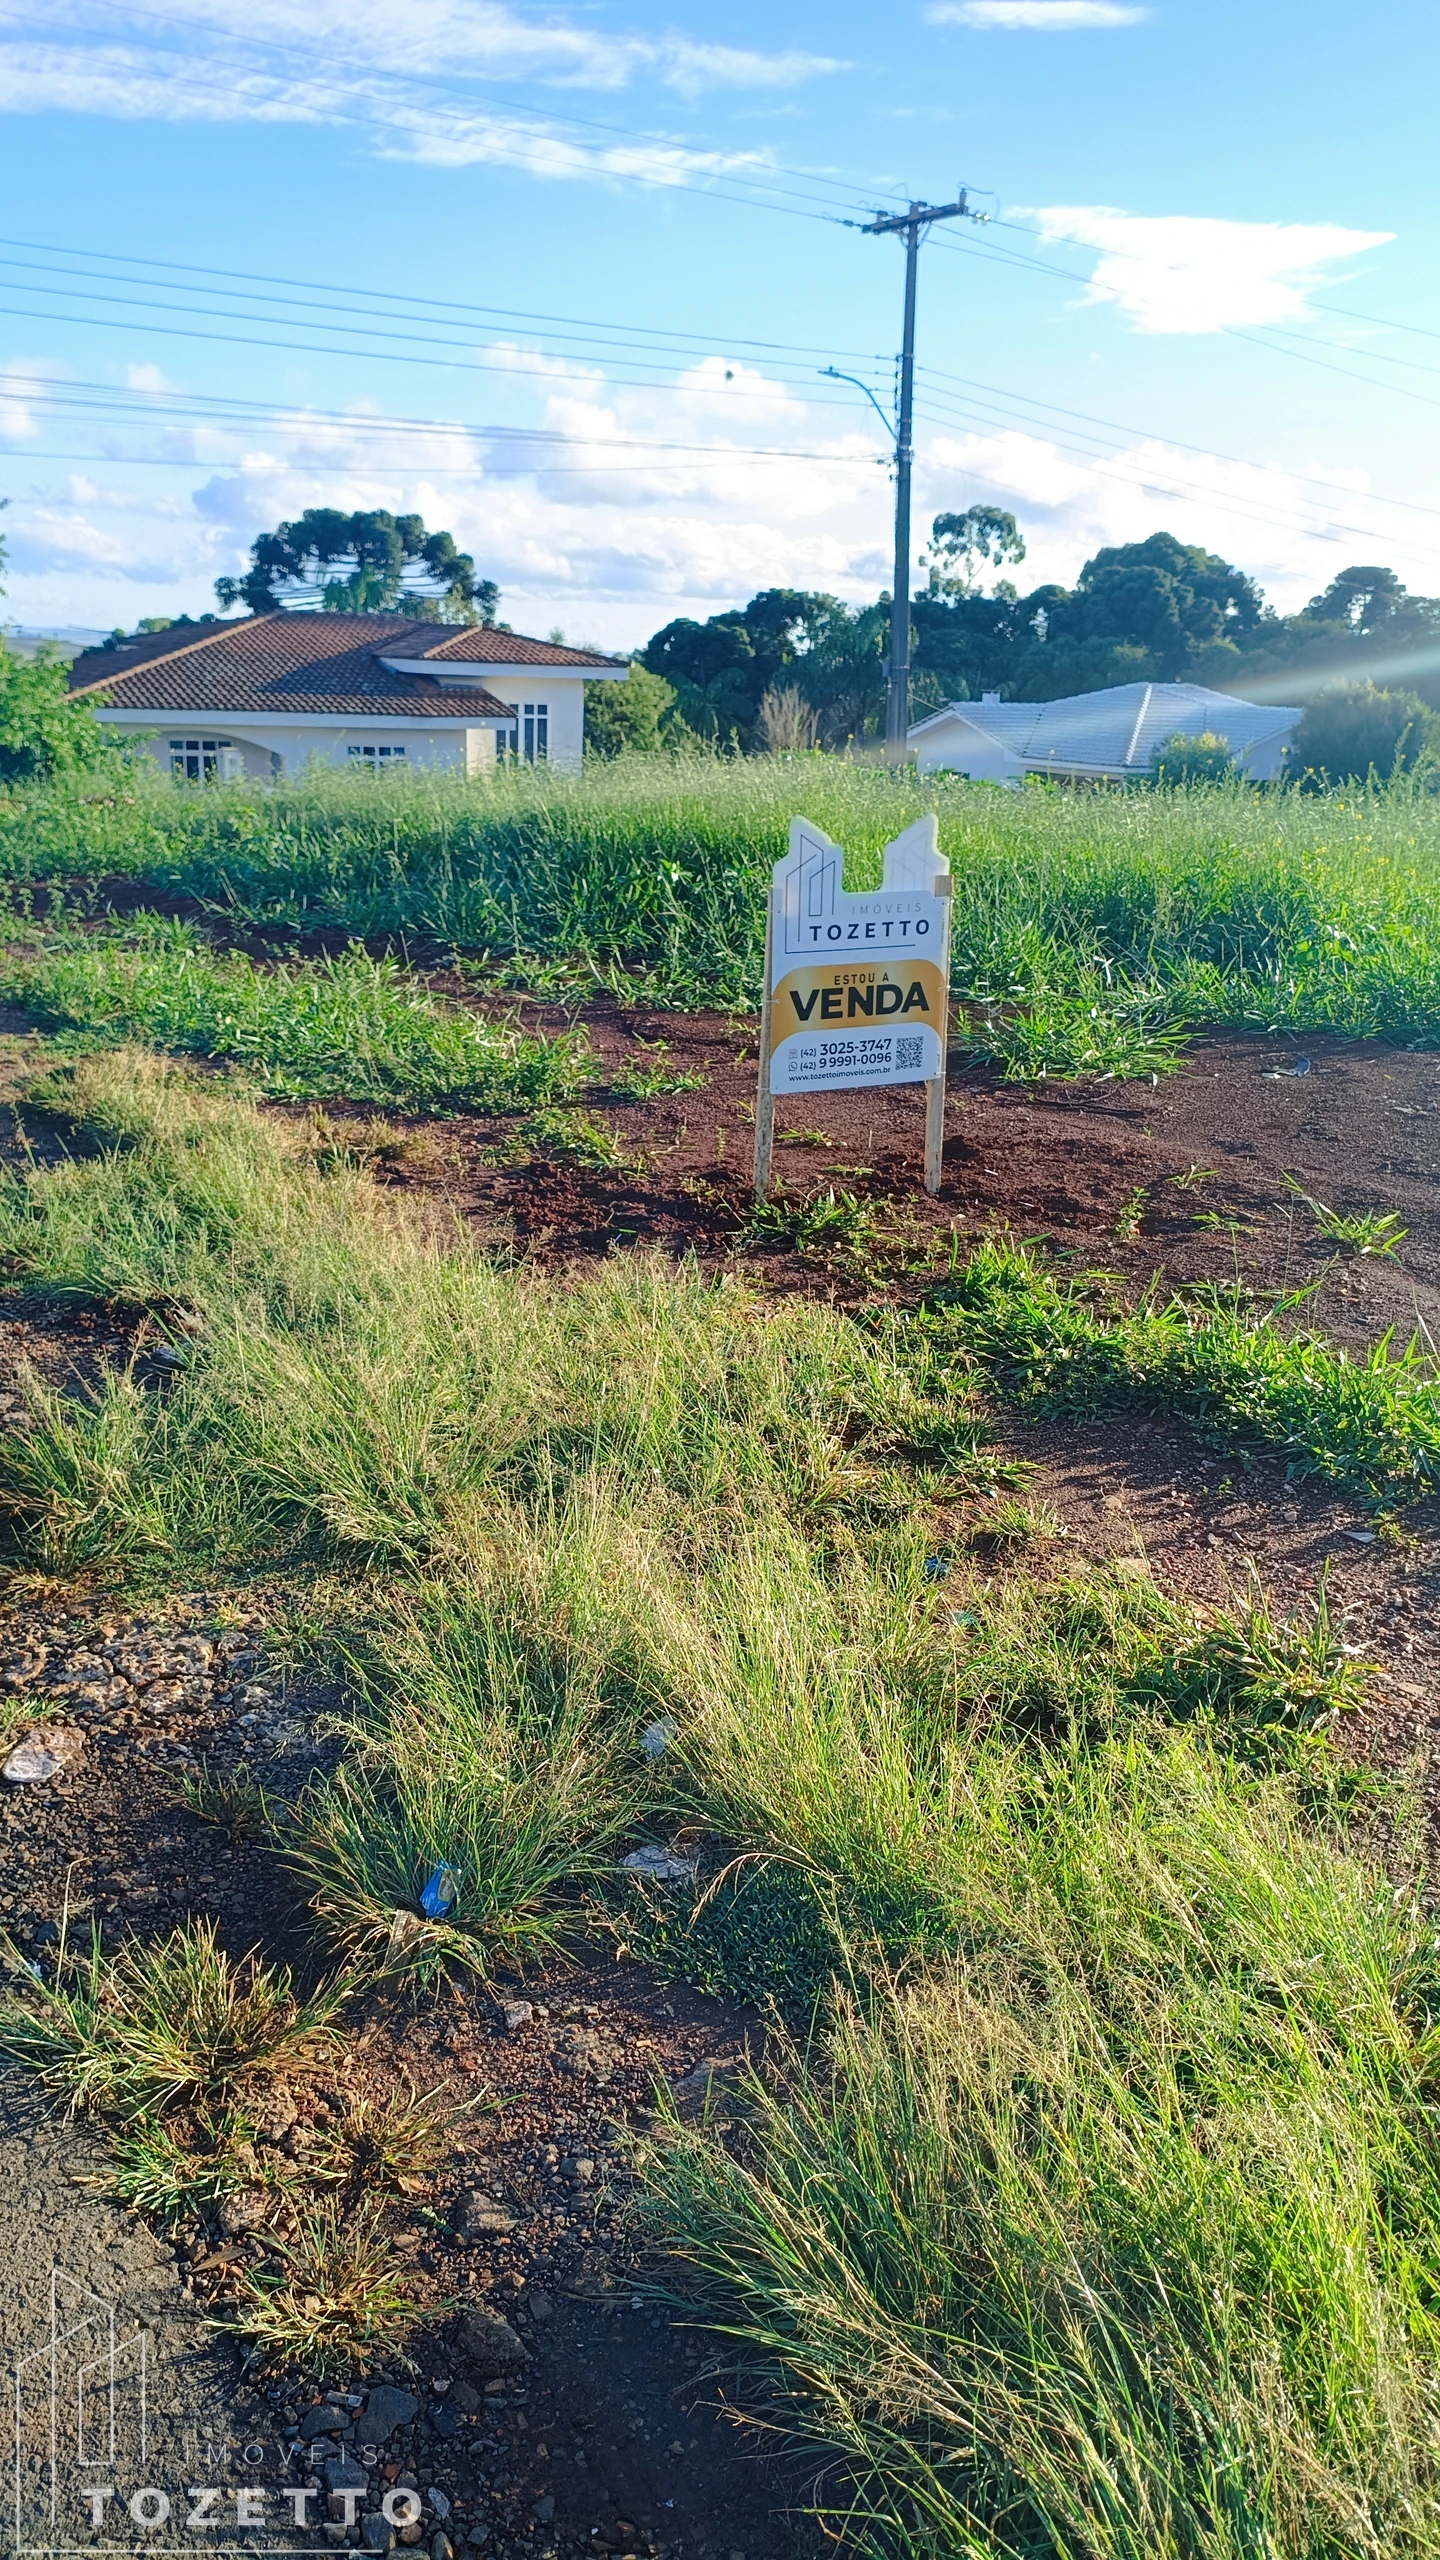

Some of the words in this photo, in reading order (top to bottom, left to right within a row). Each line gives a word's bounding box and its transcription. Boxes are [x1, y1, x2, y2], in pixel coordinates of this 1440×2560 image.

[851, 902, 922, 916] IMÓVEIS
[809, 919, 930, 942] TOZETTO
[834, 972, 876, 986] ESTOU
[882, 972, 890, 982] A
[789, 981, 930, 1022] VENDA
[800, 1048, 817, 1059] (42)
[819, 1038, 893, 1056] 3025-3747
[800, 1061, 817, 1072] (42)
[819, 1057, 827, 1069] 9
[829, 1052, 892, 1068] 9991-0096
[788, 1066, 891, 1082] www.tozettoimoveis.com.br
